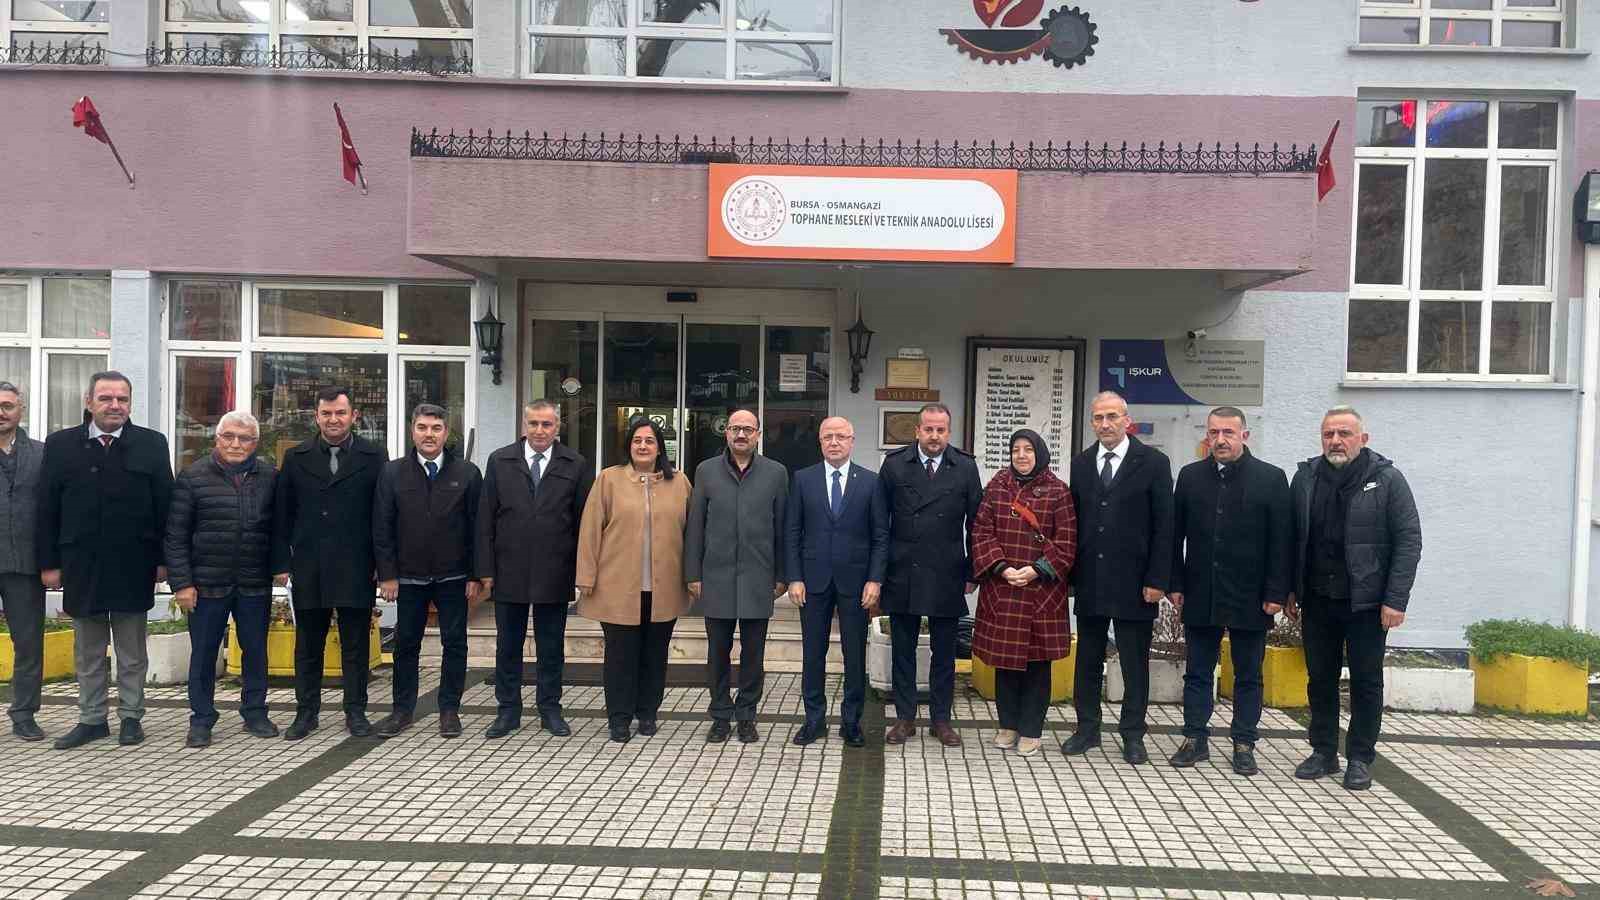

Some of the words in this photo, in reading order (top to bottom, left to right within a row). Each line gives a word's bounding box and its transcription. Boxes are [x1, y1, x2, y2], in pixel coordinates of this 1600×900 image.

[790, 200, 820, 210] BURSA
[827, 200, 881, 211] OSMANGAZİ
[790, 213, 833, 226] TOPHANE
[835, 212, 873, 227] MESLEKİ
[874, 215, 886, 227] VE
[887, 213, 919, 228] TEKNİK
[920, 216, 965, 229] ANADOLU
[967, 214, 994, 229] LİSESİ
[1002, 354, 1050, 363] OKULUMUZ
